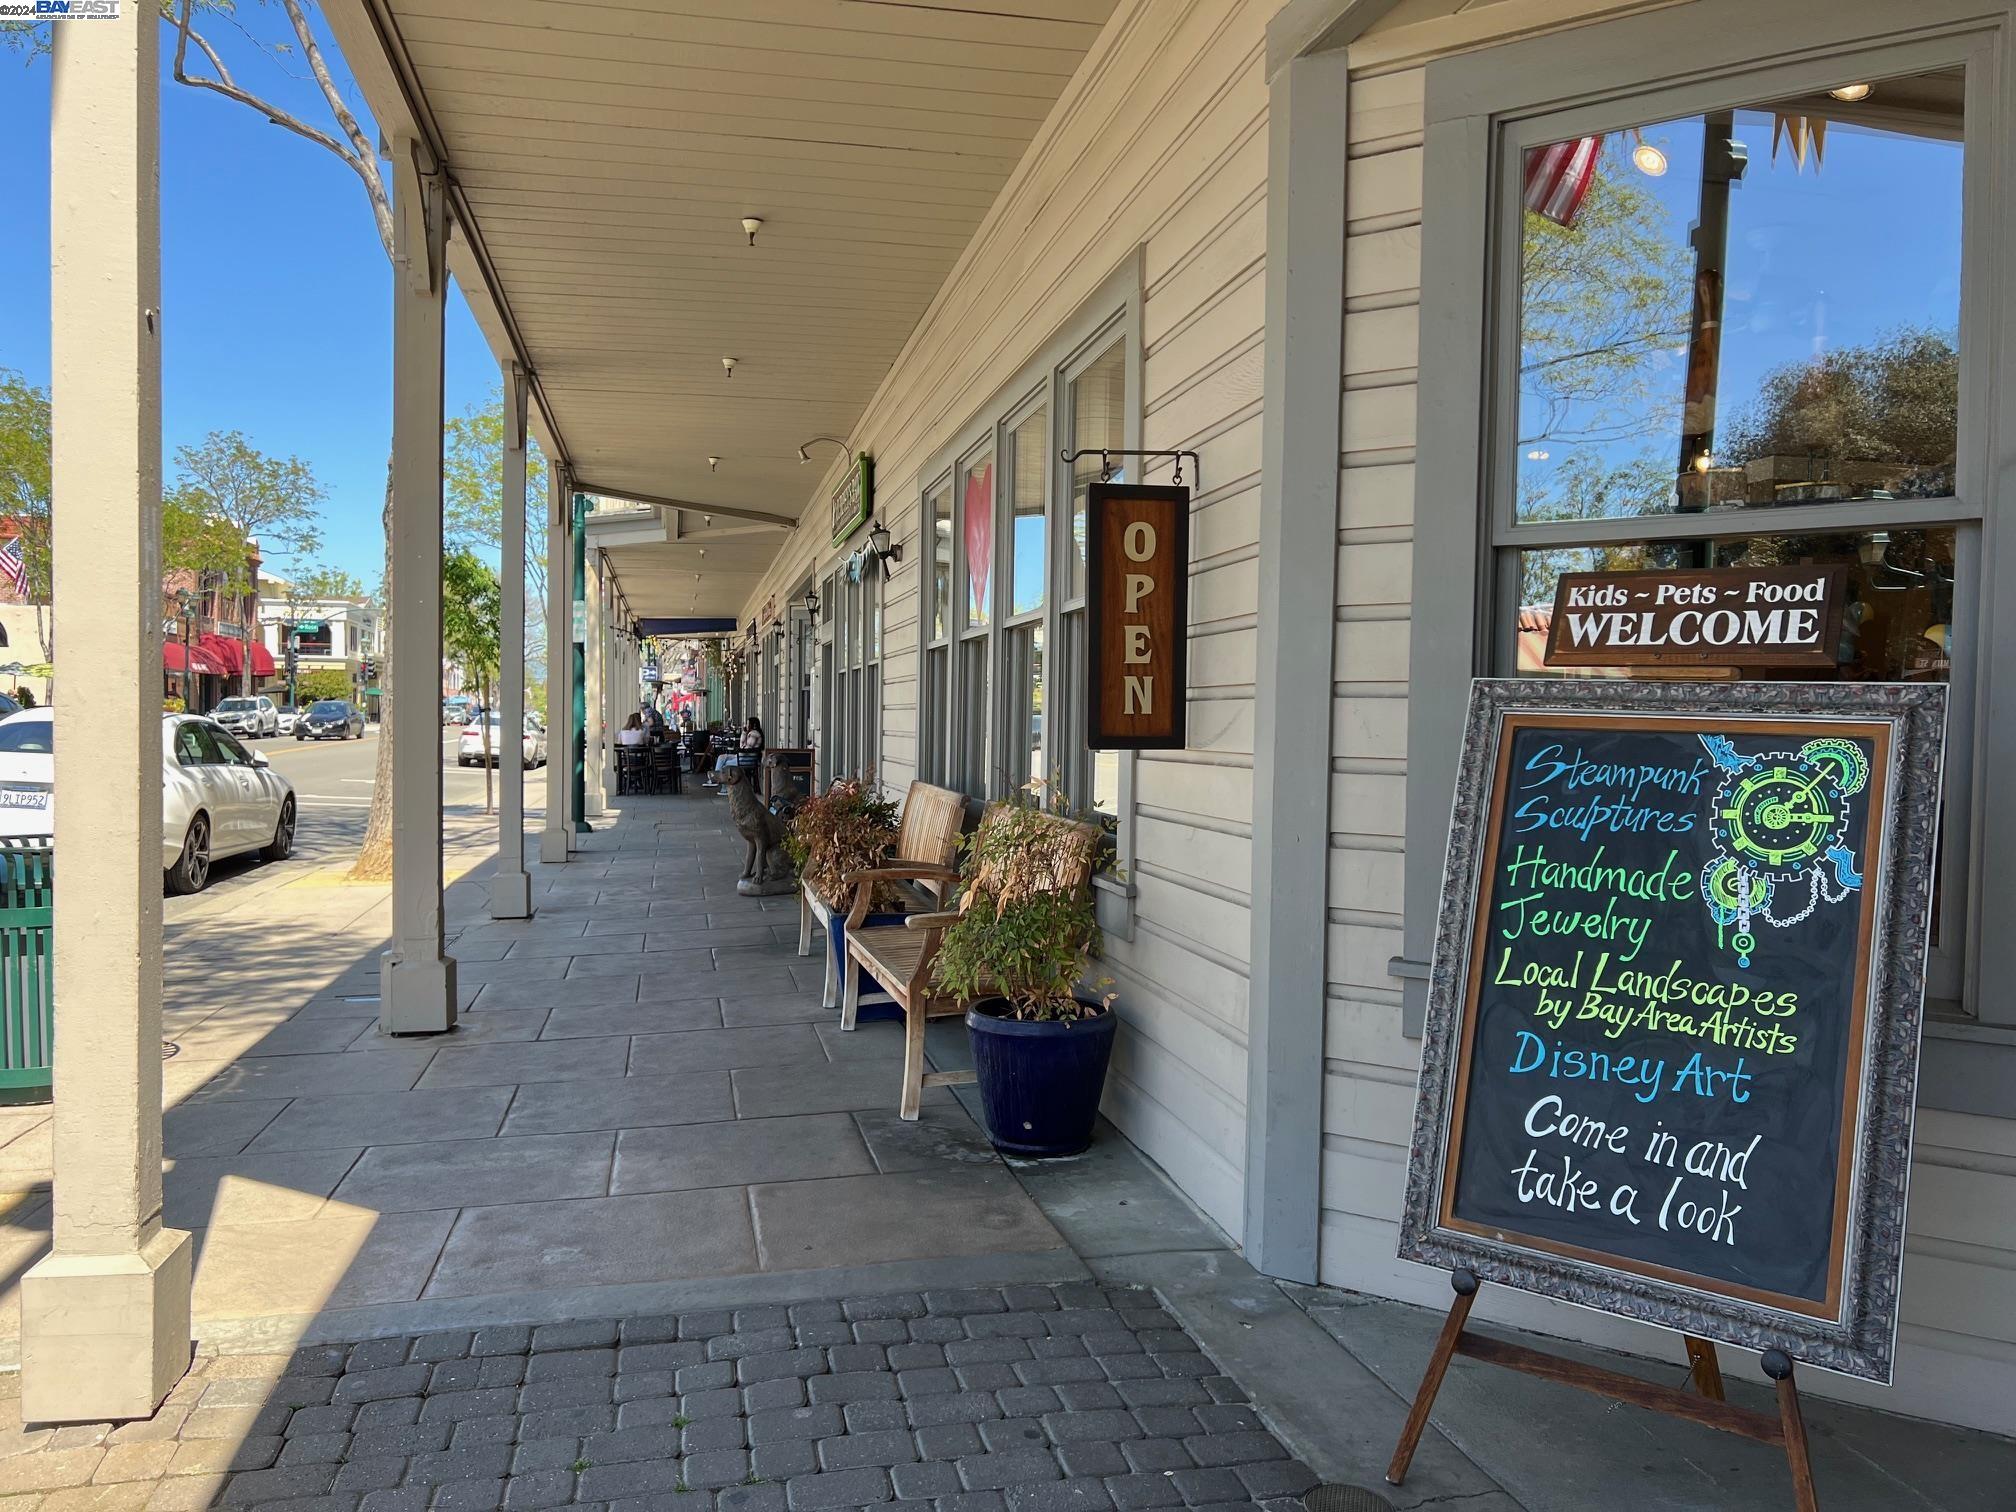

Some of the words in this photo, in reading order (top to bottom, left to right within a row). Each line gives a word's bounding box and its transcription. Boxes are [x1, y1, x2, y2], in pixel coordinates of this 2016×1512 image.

[1123, 521, 1157, 715] OPEN
[1567, 584, 1628, 607] Kids
[1654, 583, 1717, 606] Pets
[1745, 577, 1826, 603] Food
[1565, 609, 1821, 648] WELCOME
[3, 793, 45, 807] 9LIP952
[1519, 743, 1709, 802] Steampunk
[1514, 794, 1699, 841] Sculptures
[1507, 845, 1695, 901] Handmade
[1500, 892, 1652, 962] Jewelry
[1494, 947, 1583, 989] Local
[1590, 952, 1798, 1023] Landscapes
[1533, 989, 1572, 1030] by
[1575, 992, 1636, 1039] Bay
[1631, 1001, 1698, 1035] Area
[1696, 1010, 1799, 1056] Artists
[1509, 1030, 1665, 1103] Disney
[1672, 1052, 1752, 1103] Art
[1524, 1094, 1629, 1154] Come
[1644, 1120, 1678, 1169] in
[1685, 1134, 1762, 1190] and
[1511, 1149, 1601, 1212] take
[1610, 1184, 1641, 1225] a
[1658, 1176, 1743, 1246] look
